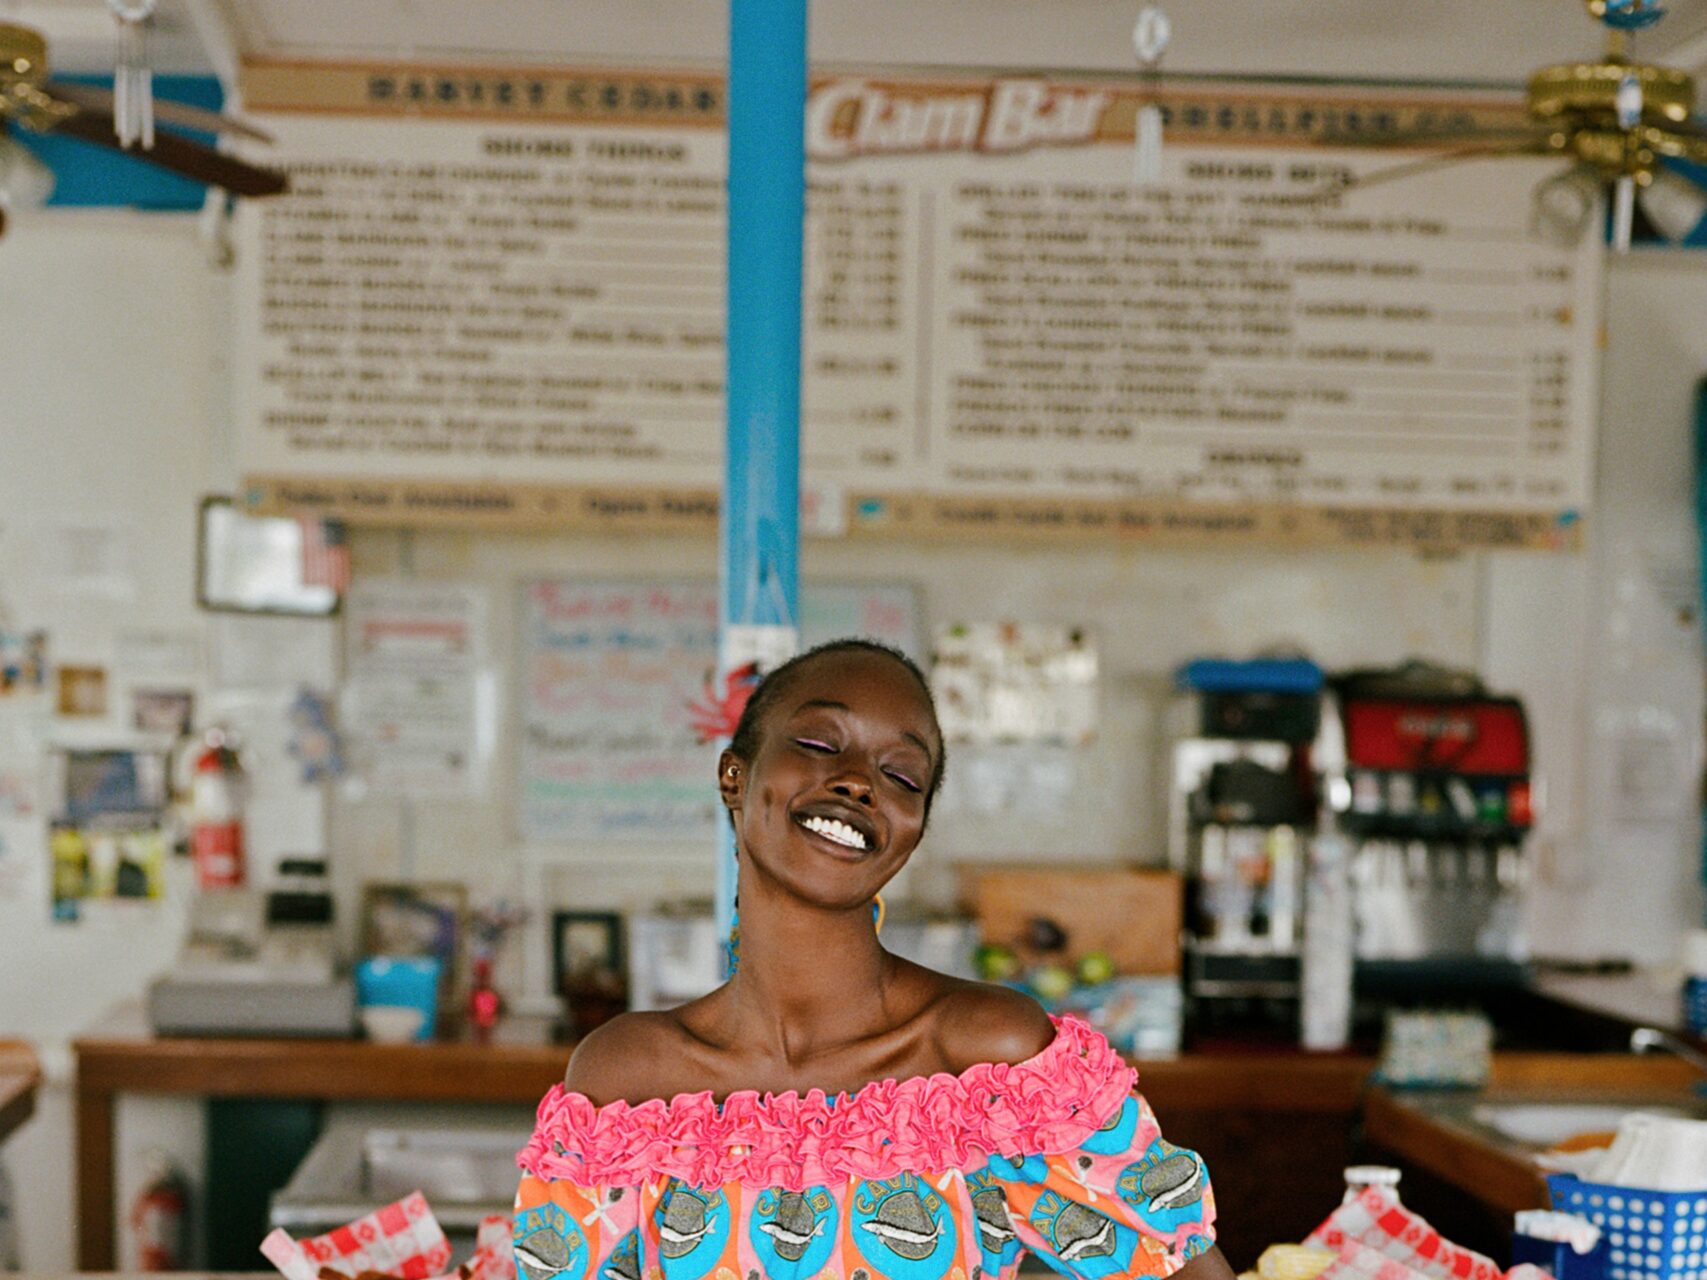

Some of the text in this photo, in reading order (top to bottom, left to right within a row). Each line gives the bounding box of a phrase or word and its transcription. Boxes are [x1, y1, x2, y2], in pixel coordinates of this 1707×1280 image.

[804, 76, 1108, 158] Clam Bar
[856, 1173, 942, 1215] CAVIR
